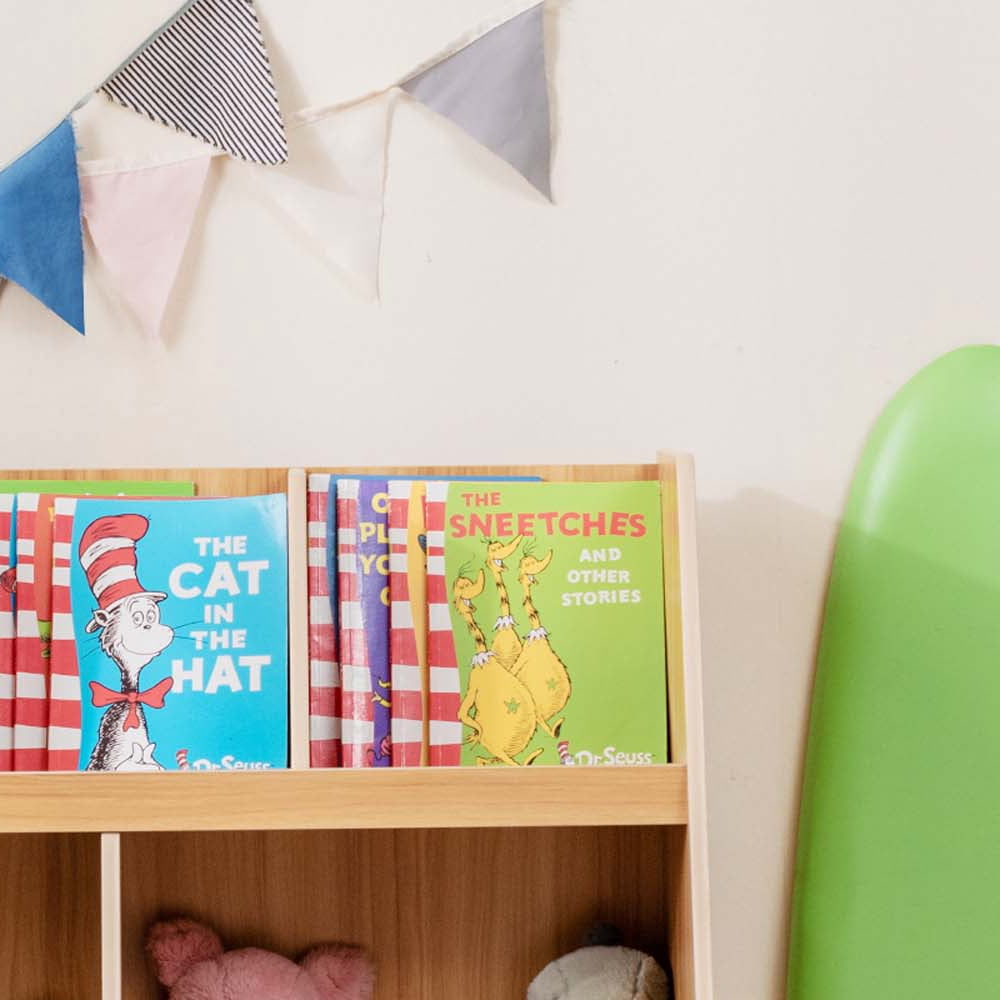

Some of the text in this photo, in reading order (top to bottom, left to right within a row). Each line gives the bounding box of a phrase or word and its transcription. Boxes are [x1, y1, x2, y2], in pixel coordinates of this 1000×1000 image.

[461, 492, 501, 507] THE
[449, 511, 647, 538] SNEETCHES
[193, 535, 248, 557] THE
[579, 547, 622, 563] AND
[168, 560, 270, 599] CAT
[567, 569, 631, 584] OTHER
[561, 589, 642, 607] STORIES
[203, 602, 234, 625] IN
[189, 629, 247, 650] THE
[170, 654, 272, 694] HAT
